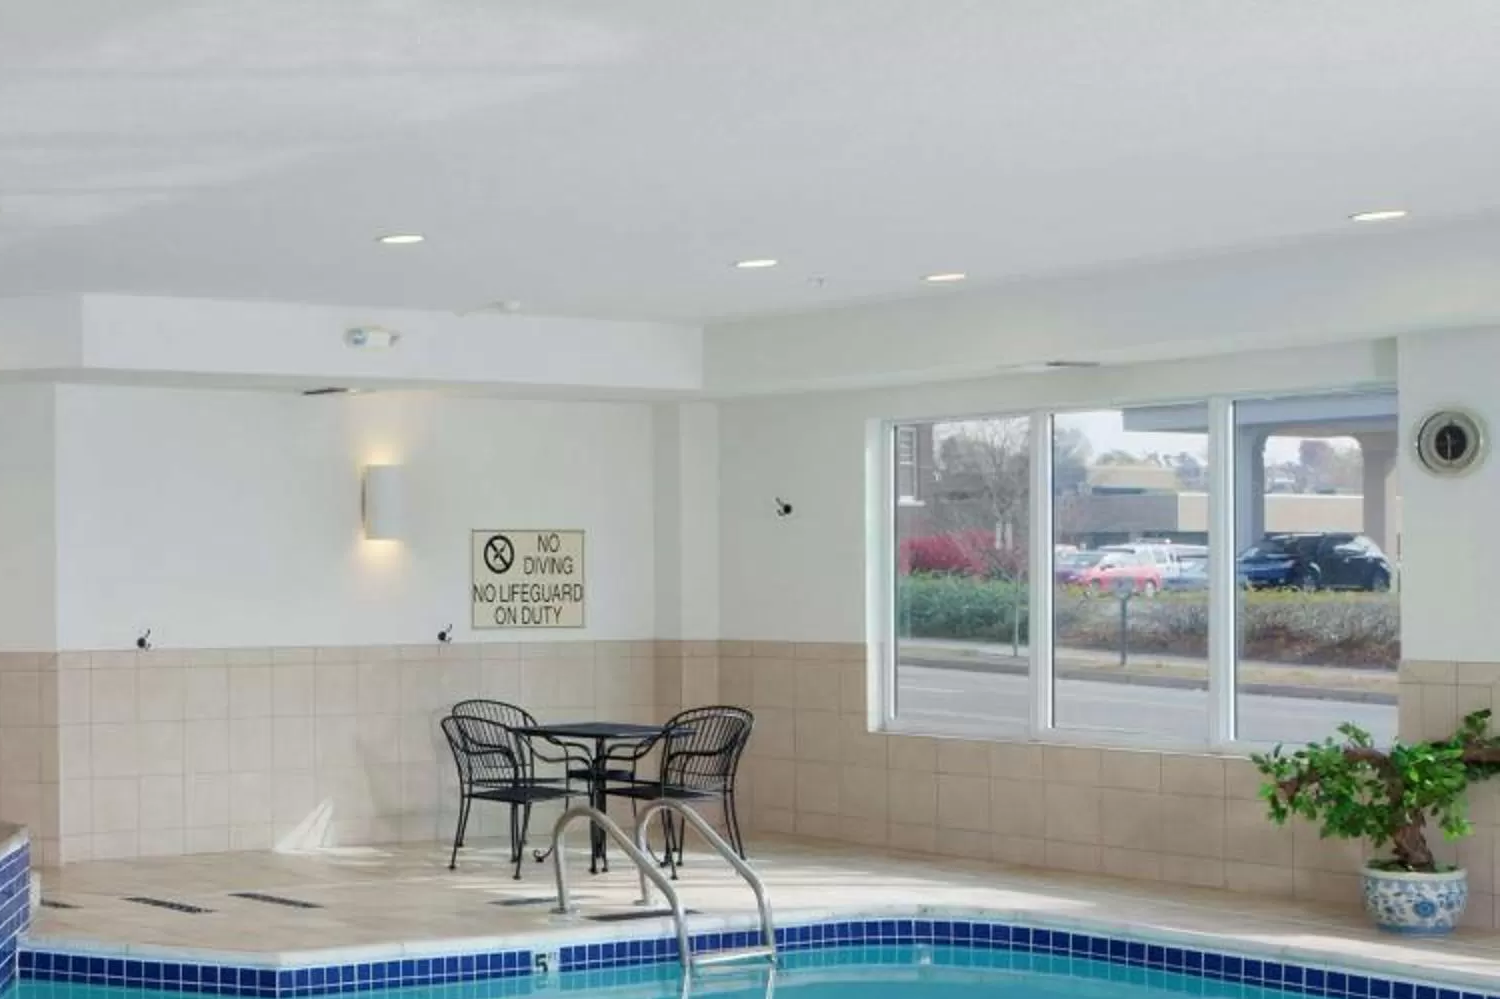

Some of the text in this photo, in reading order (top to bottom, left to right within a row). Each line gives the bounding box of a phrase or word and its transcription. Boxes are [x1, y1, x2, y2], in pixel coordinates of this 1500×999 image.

[537, 533, 560, 552] NO
[523, 556, 573, 575] DIVING
[473, 583, 584, 603] NO LIFEGUARD
[494, 606, 563, 625] ON DUTY
